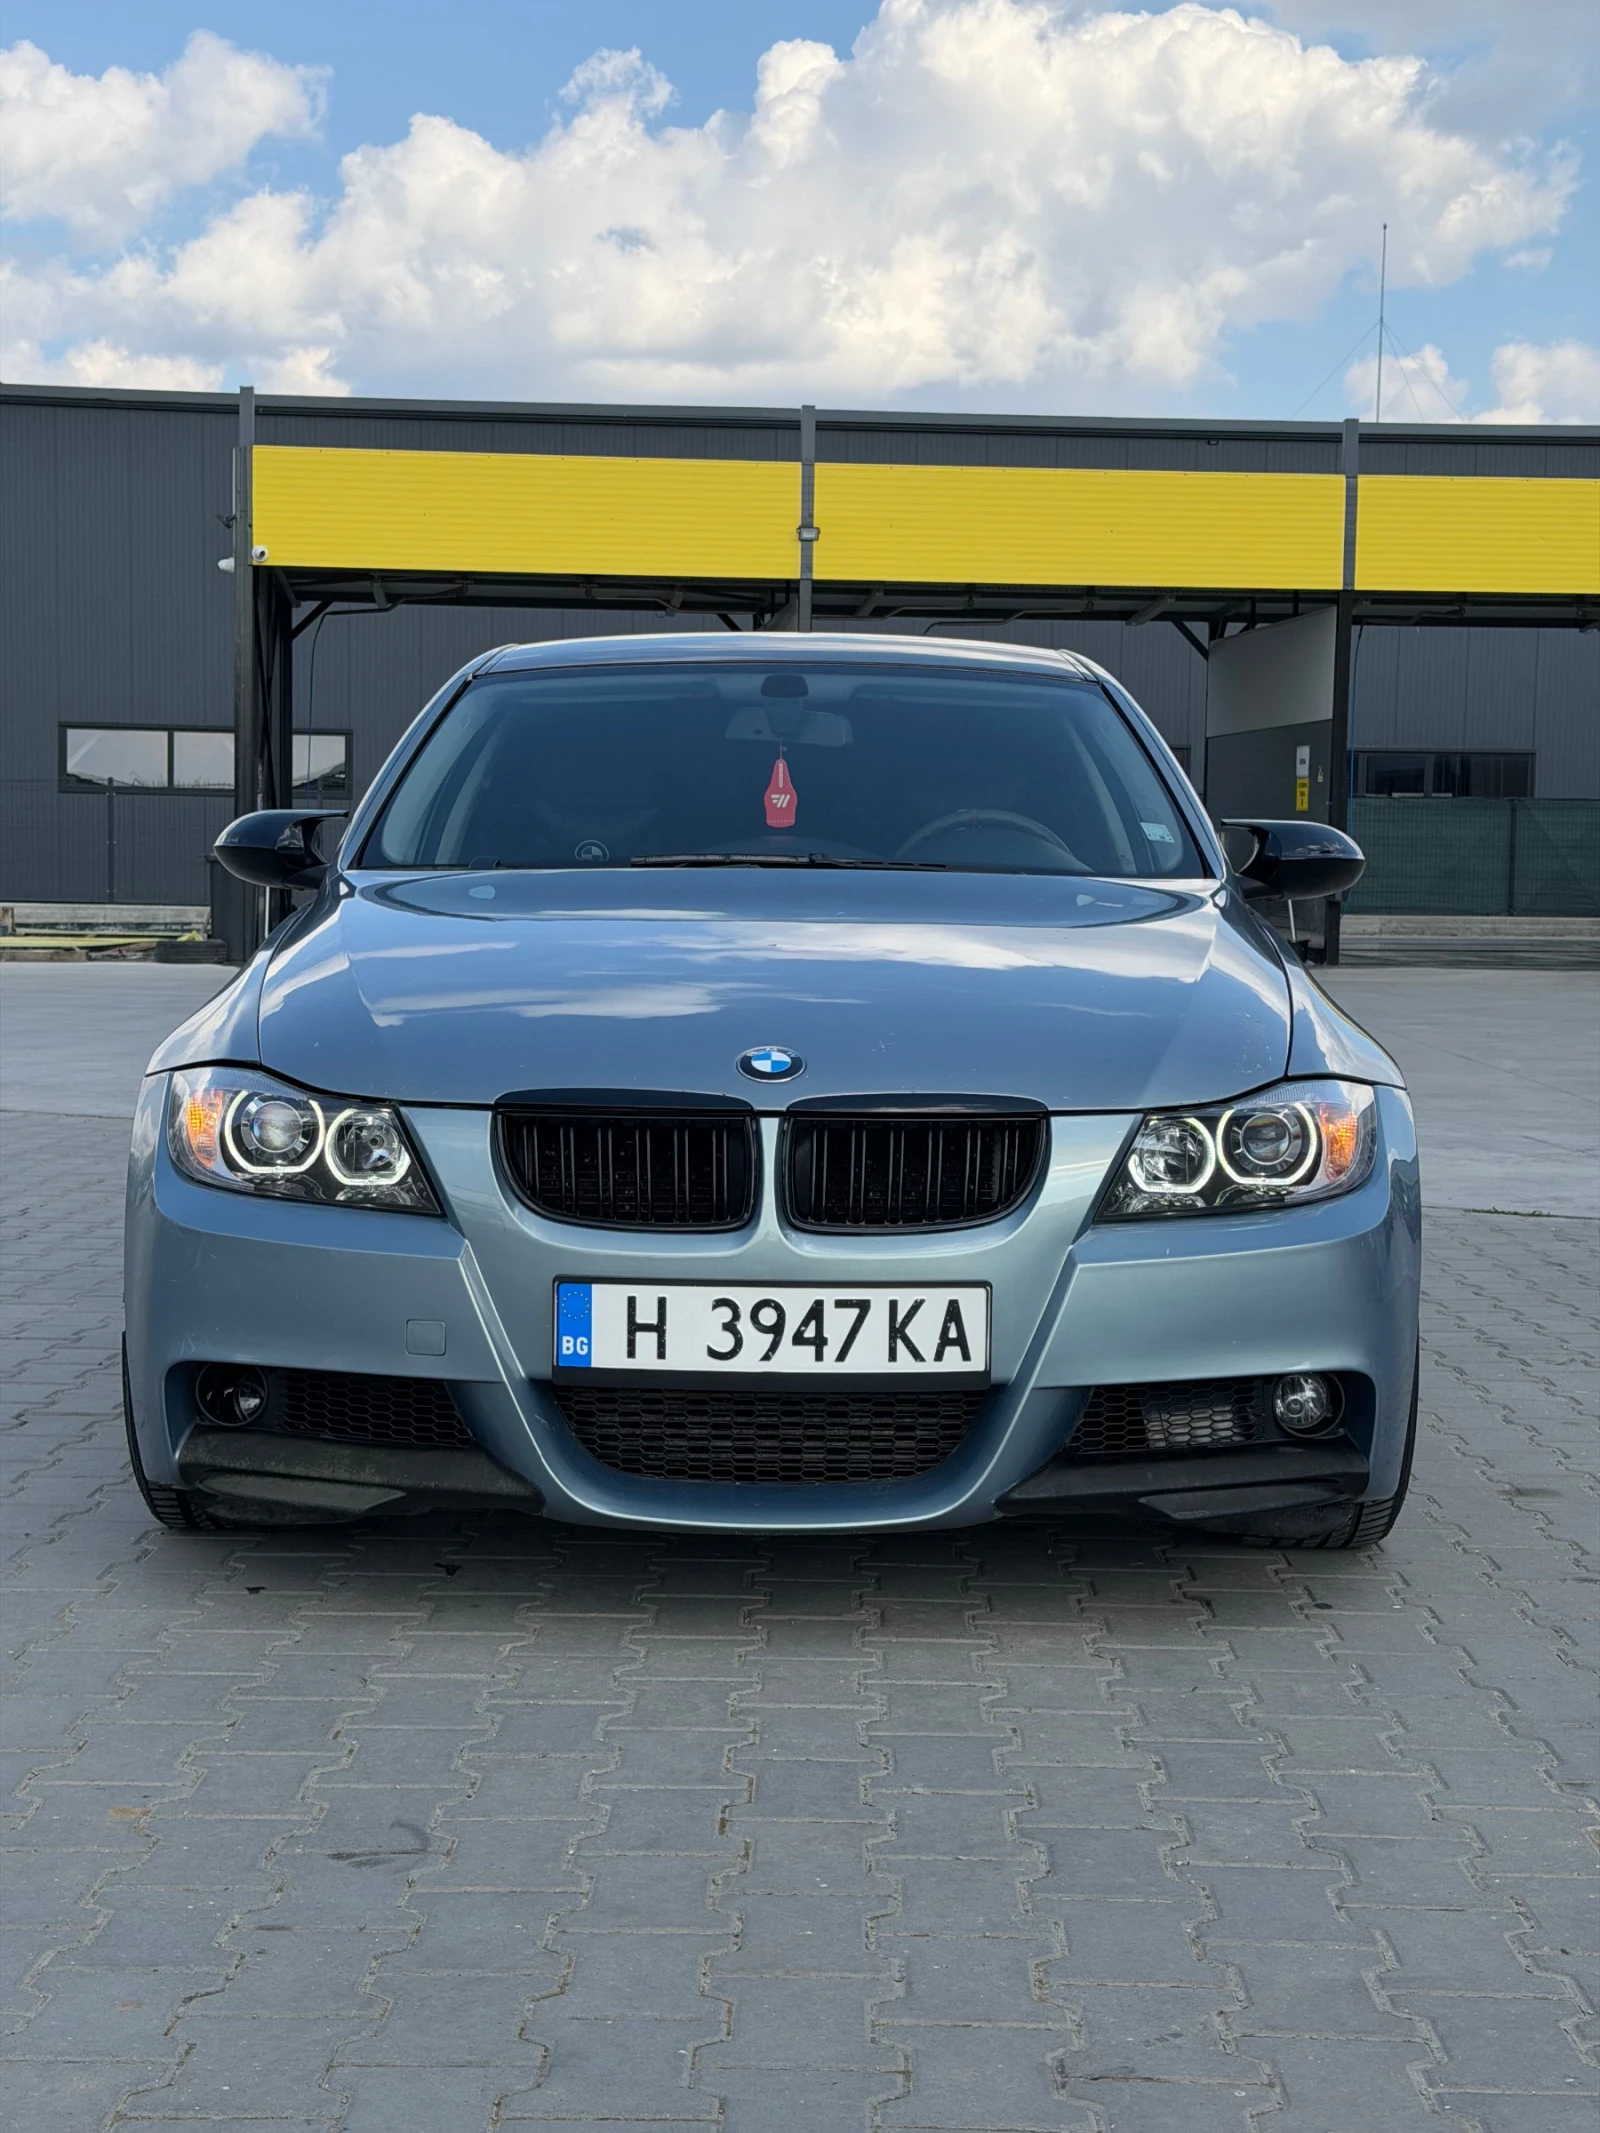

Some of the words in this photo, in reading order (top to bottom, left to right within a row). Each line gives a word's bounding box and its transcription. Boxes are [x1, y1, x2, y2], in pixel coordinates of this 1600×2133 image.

[746, 1047, 798, 1058] BMW
[626, 1295, 667, 1360] H
[707, 1297, 871, 1363] 3947
[887, 1298, 972, 1363] KA
[562, 1335, 589, 1355] BG
